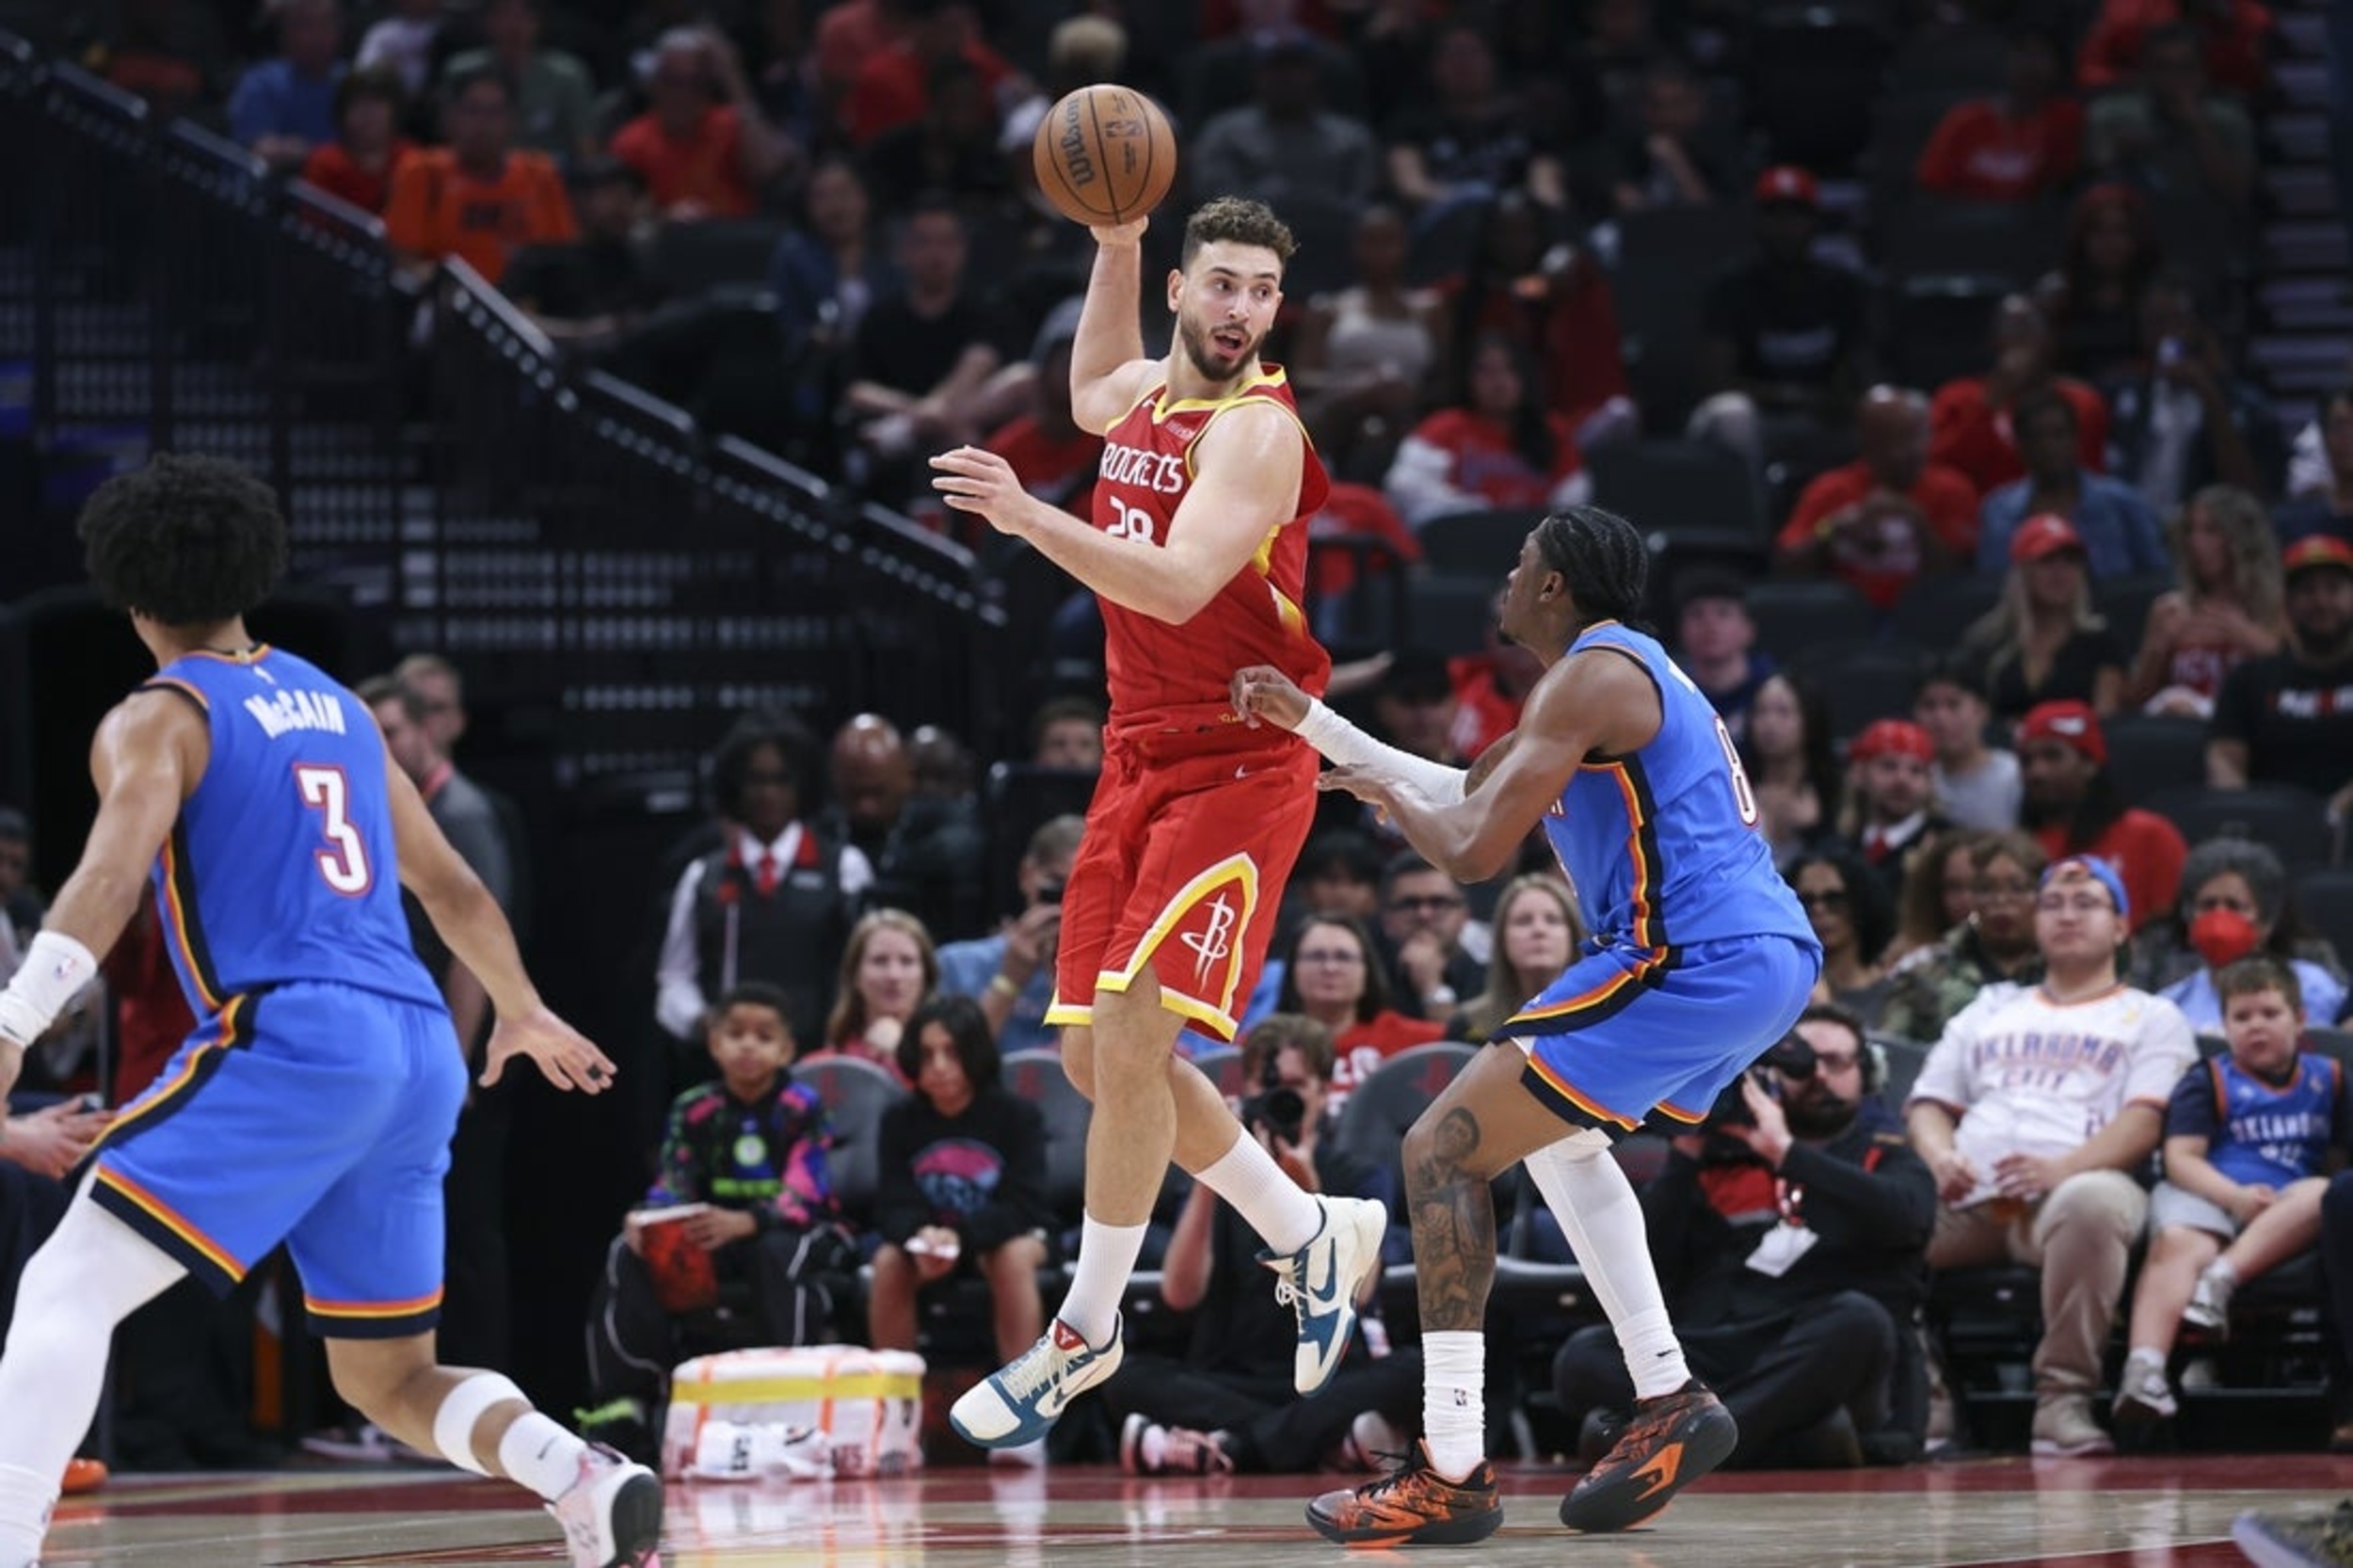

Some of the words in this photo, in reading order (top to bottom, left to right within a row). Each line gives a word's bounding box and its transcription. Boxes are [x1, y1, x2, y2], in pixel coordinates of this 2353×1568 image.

[1062, 98, 1096, 186] Wilson
[1099, 442, 1183, 493] ROCKETS
[243, 689, 346, 740] McCAIN
[1715, 713, 1760, 827] 8
[294, 762, 374, 897] 3
